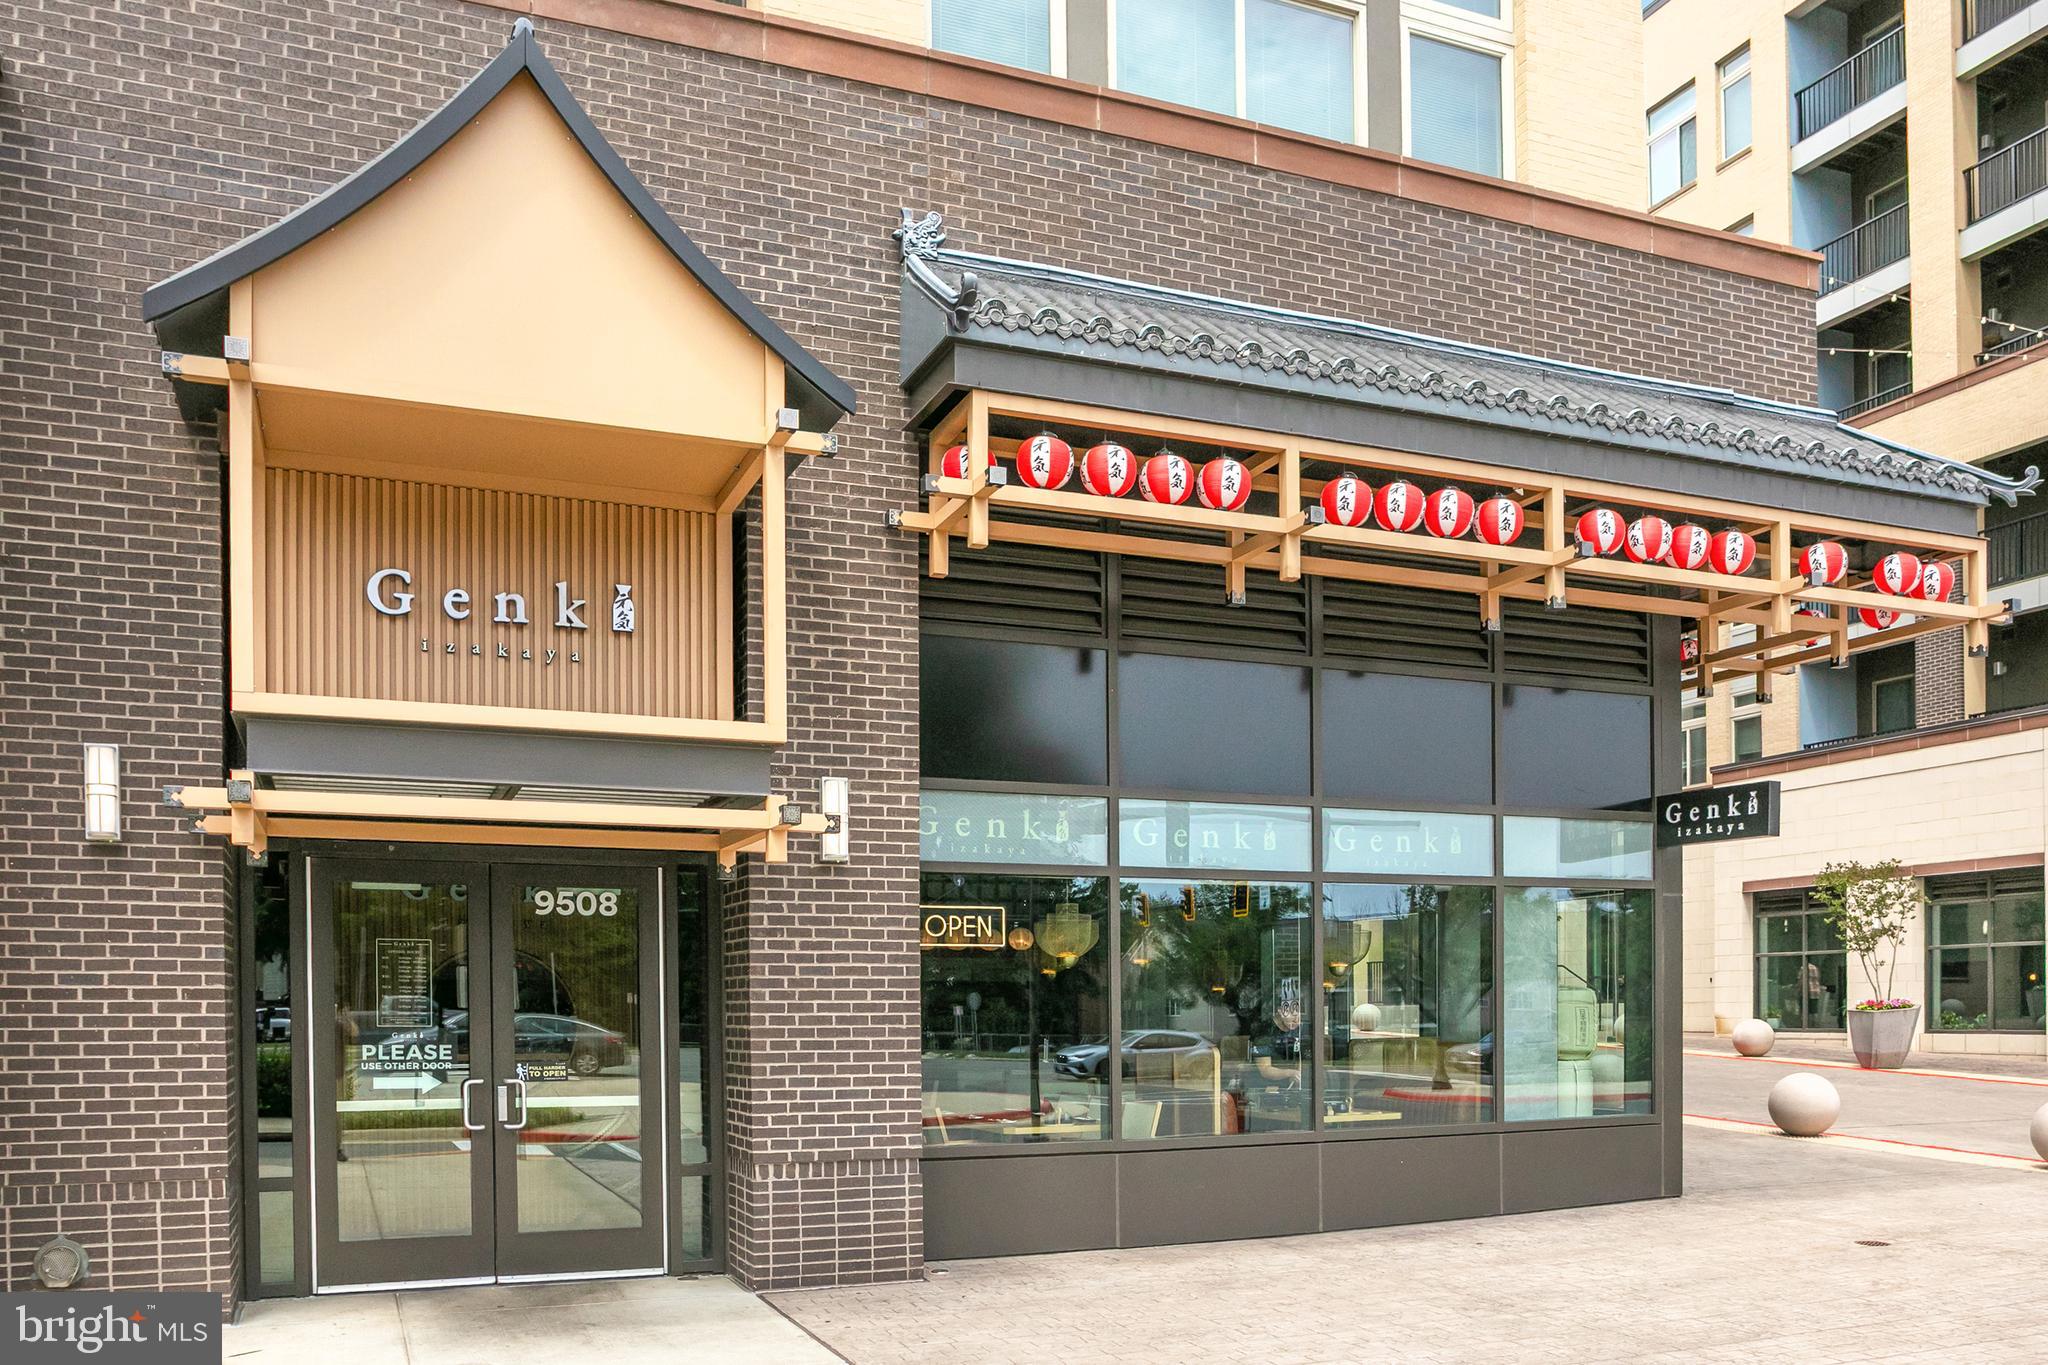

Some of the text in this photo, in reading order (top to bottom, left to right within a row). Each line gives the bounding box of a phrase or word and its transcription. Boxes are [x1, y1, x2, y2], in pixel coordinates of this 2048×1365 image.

[421, 638, 580, 665] izakaya
[1677, 822, 1745, 837] izakaya
[534, 890, 619, 917] 9508
[925, 914, 992, 938] OPEN
[361, 1044, 453, 1061] PLEASE
[361, 1062, 452, 1070] USE OTHER DOOR
